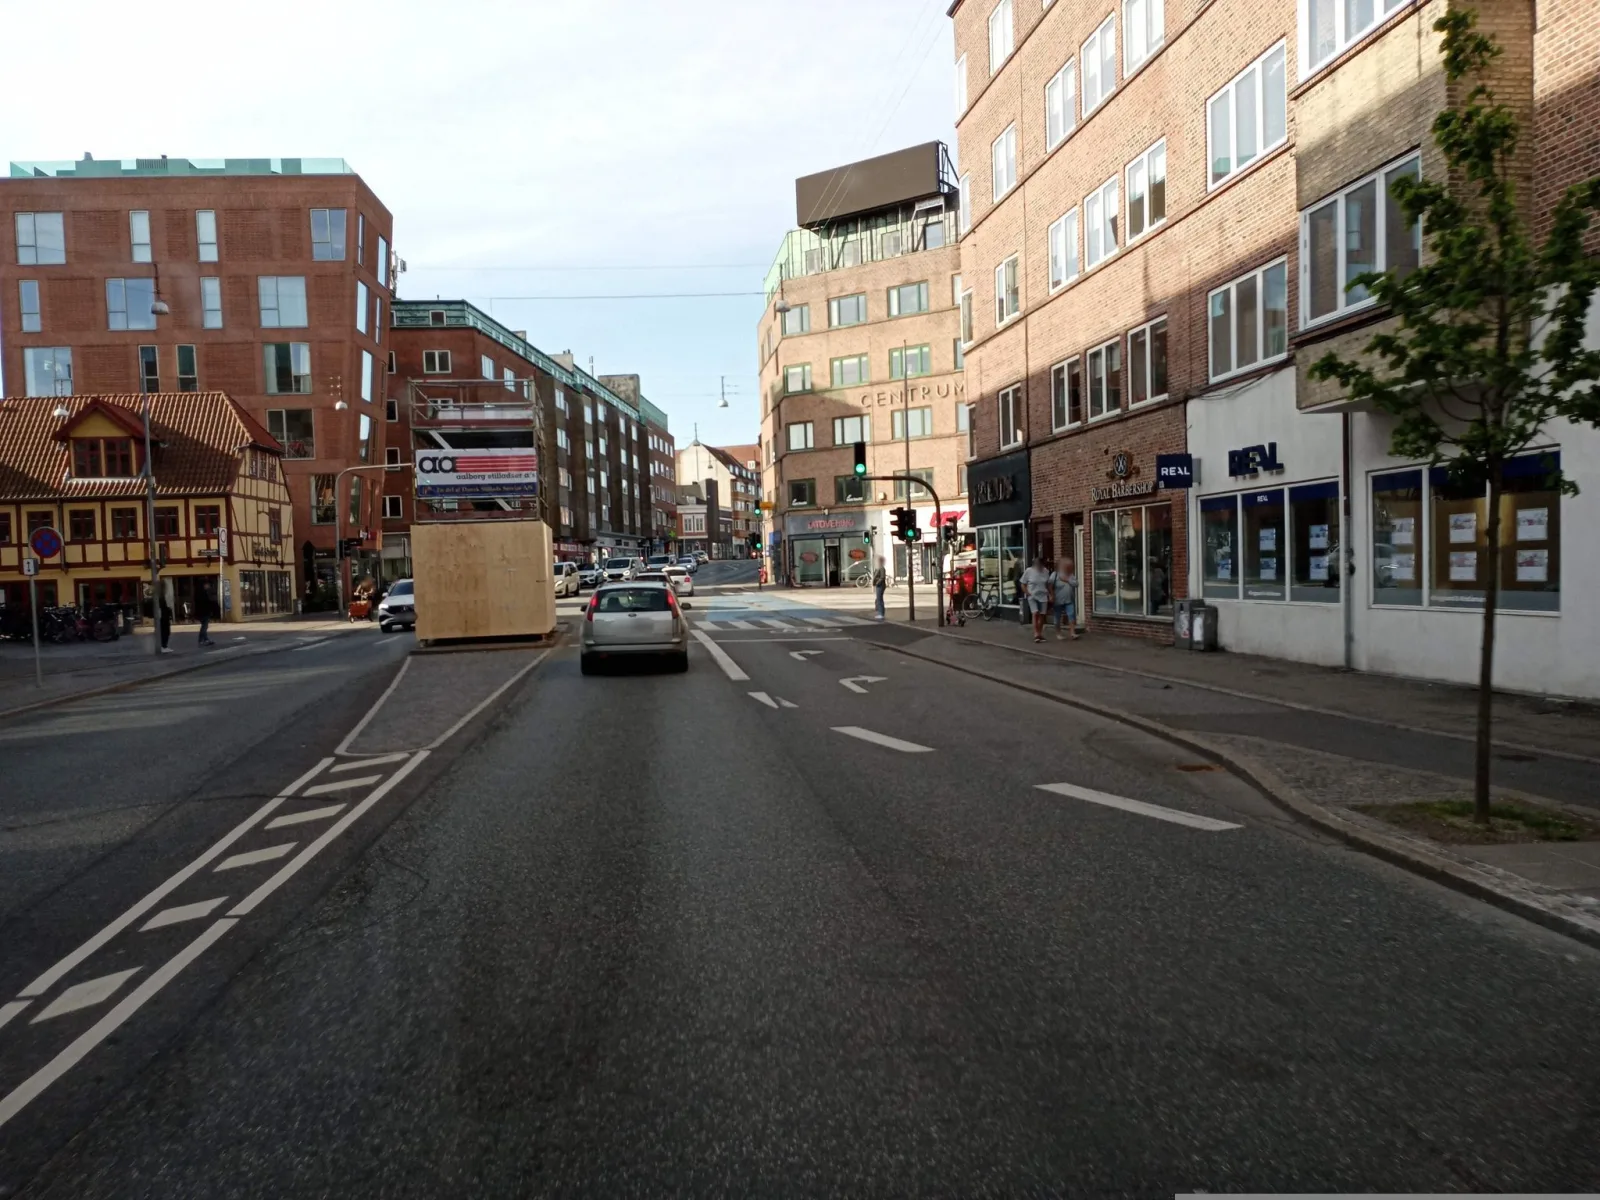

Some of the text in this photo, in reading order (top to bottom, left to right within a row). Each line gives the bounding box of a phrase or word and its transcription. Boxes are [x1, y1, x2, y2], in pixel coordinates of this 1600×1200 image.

[861, 382, 964, 408] CENTRUM
[1228, 441, 1284, 477] REAL
[456, 472, 486, 480] aalborg
[487, 472, 522, 480] stilladser
[1161, 466, 1190, 476] REAL
